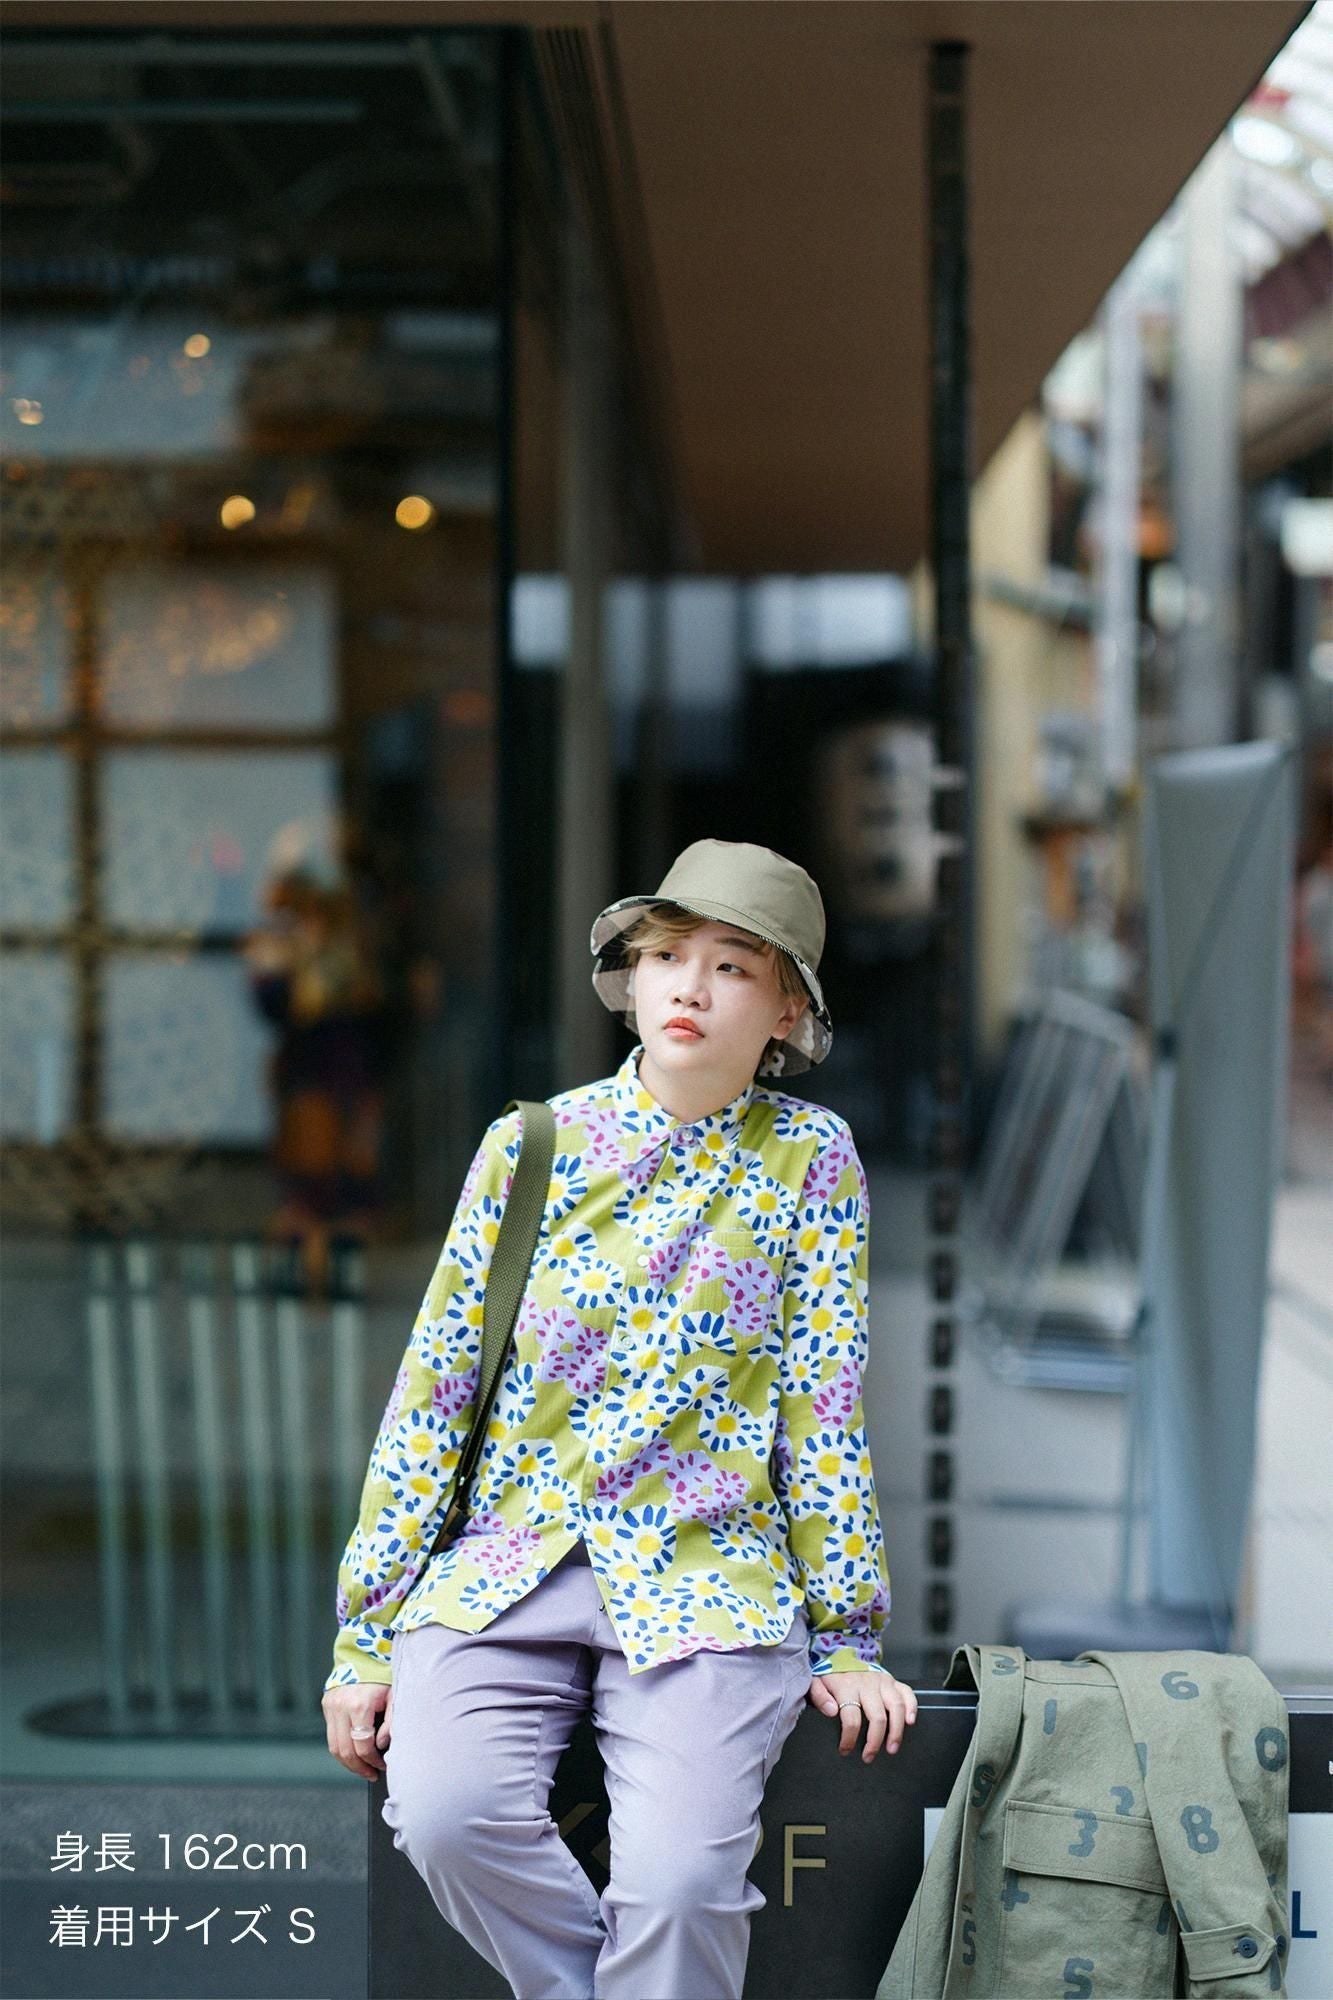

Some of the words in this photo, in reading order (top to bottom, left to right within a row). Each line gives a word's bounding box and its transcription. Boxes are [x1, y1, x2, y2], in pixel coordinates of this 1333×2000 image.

[1161, 1671, 1199, 1700] 6
[1068, 1808, 1098, 1857] 3
[1180, 1805, 1220, 1854] 8
[1292, 1891, 1317, 1938] L
